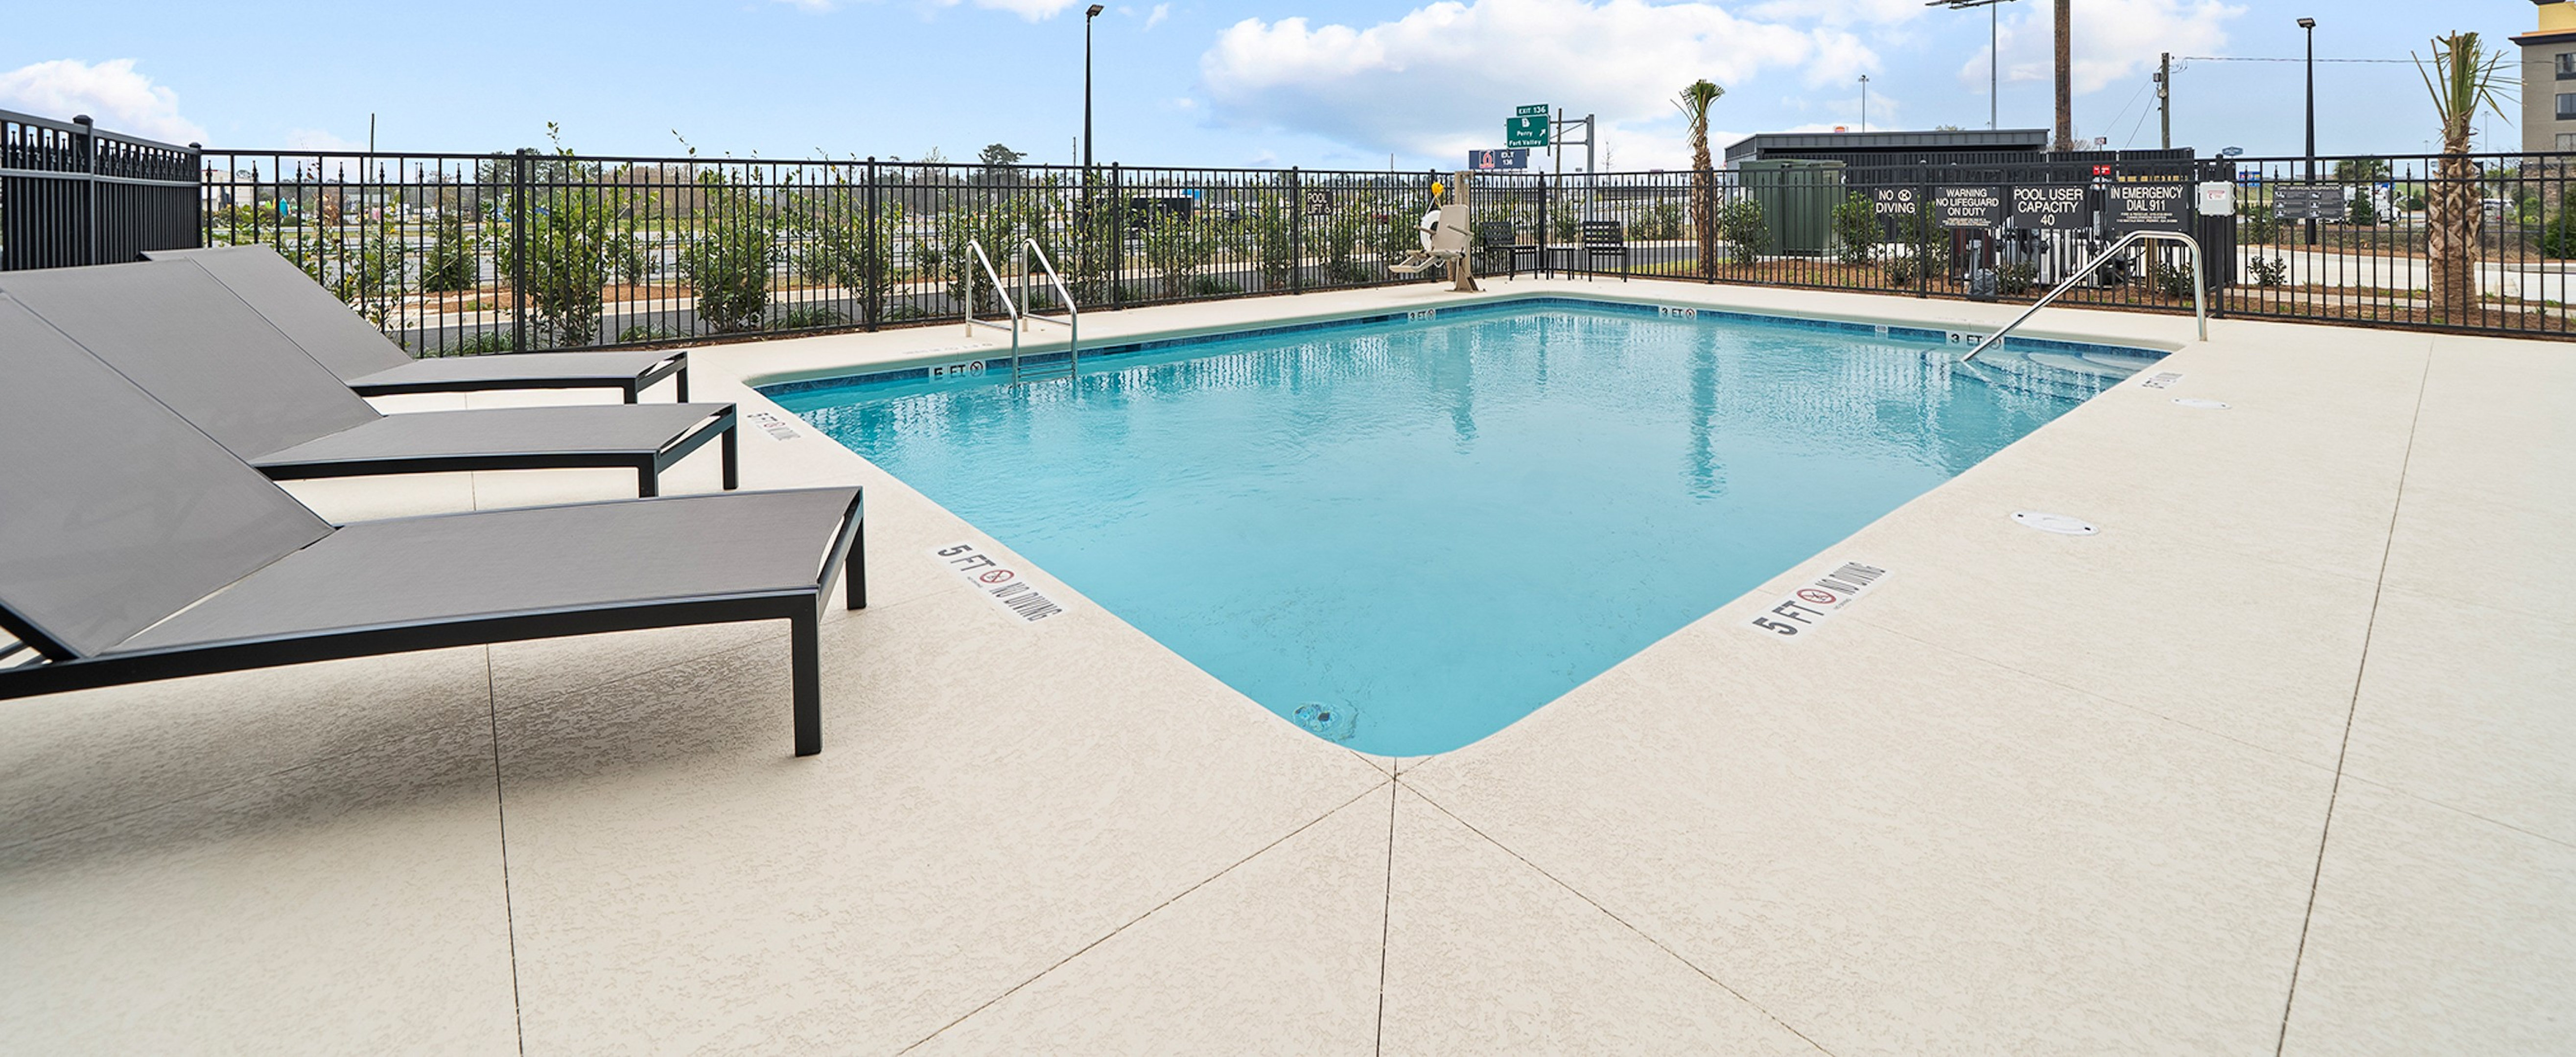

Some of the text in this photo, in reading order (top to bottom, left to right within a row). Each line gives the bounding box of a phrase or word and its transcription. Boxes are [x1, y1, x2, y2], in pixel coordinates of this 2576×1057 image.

[1879, 189, 1894, 201] NO
[1946, 188, 1988, 197] WARNING
[2014, 188, 2084, 201] POOL USER
[2111, 186, 2183, 199] IN EMERGENCY
[1876, 202, 1915, 214] DIVING
[1936, 197, 1999, 207] NO LIFEGUARD
[2018, 201, 2079, 213] CAPACITY
[2127, 200, 2165, 211] DIAL 911
[1308, 204, 1322, 214] LIFT
[1947, 207, 1986, 216] ON DUTY
[2040, 213, 2055, 226] 40
[1951, 333, 1960, 344] 3
[938, 544, 973, 556] 5
[950, 554, 996, 571] FT
[989, 582, 1029, 597] NO
[1004, 592, 1062, 621] DIVING
[1772, 600, 1824, 624] FT
[1753, 617, 1798, 635] 5
